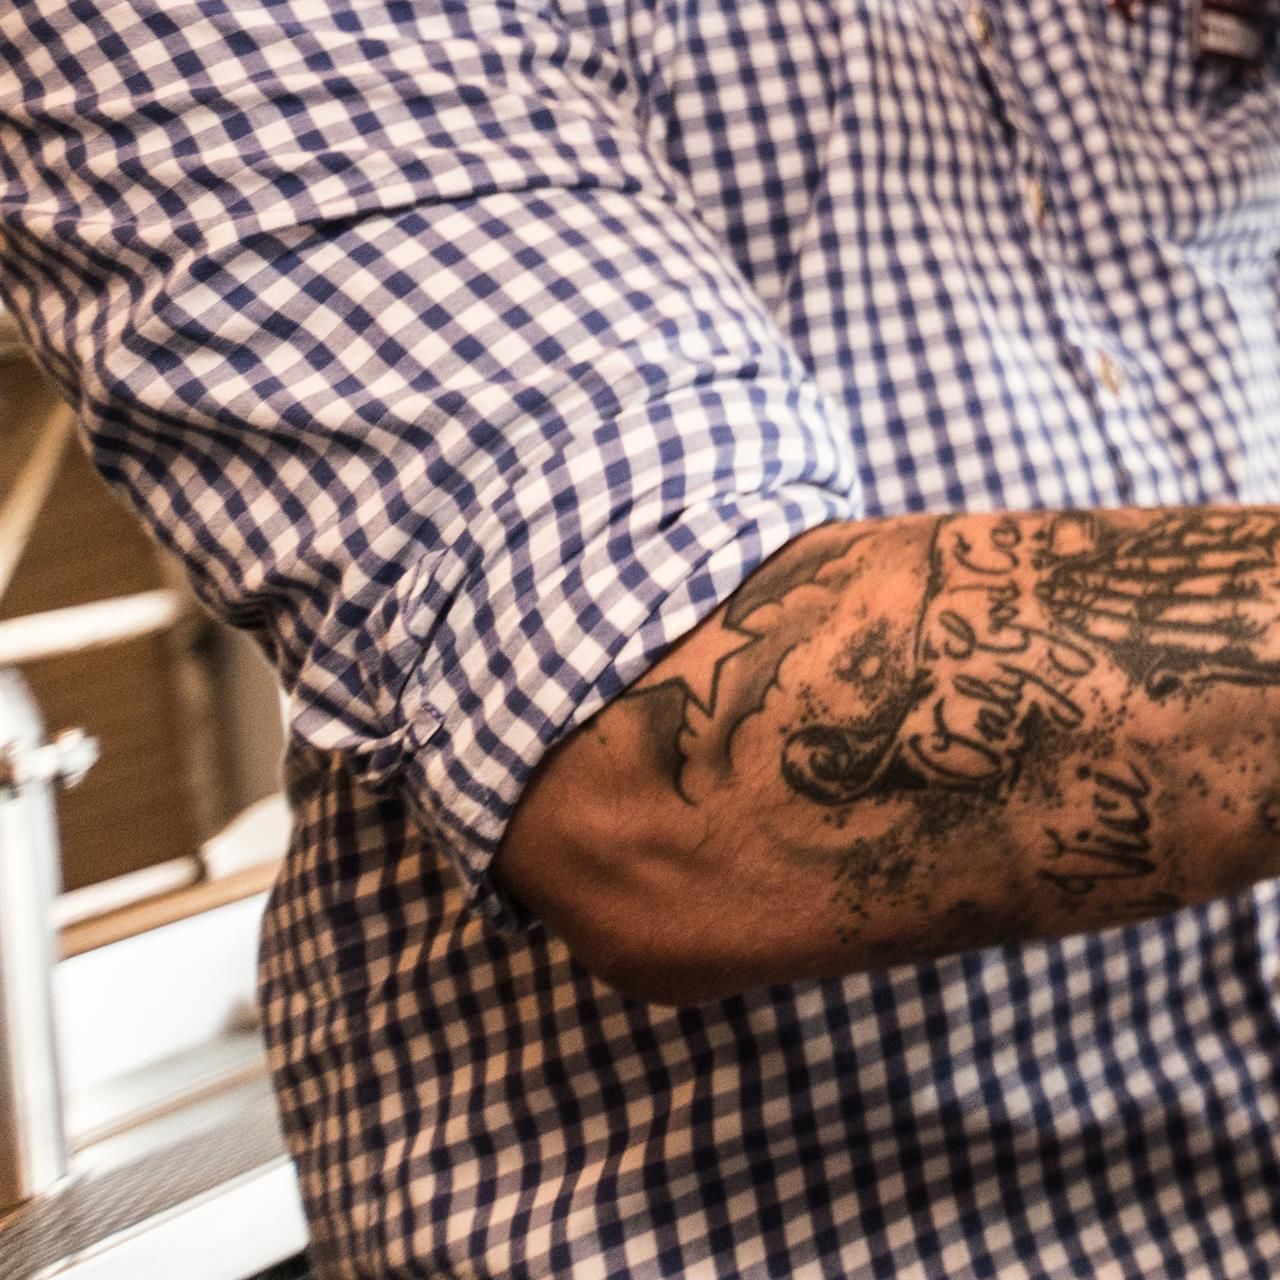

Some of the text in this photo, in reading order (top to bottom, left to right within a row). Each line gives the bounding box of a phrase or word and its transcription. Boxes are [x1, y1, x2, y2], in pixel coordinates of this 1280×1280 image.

[908, 515, 1097, 783] Only God Ca
